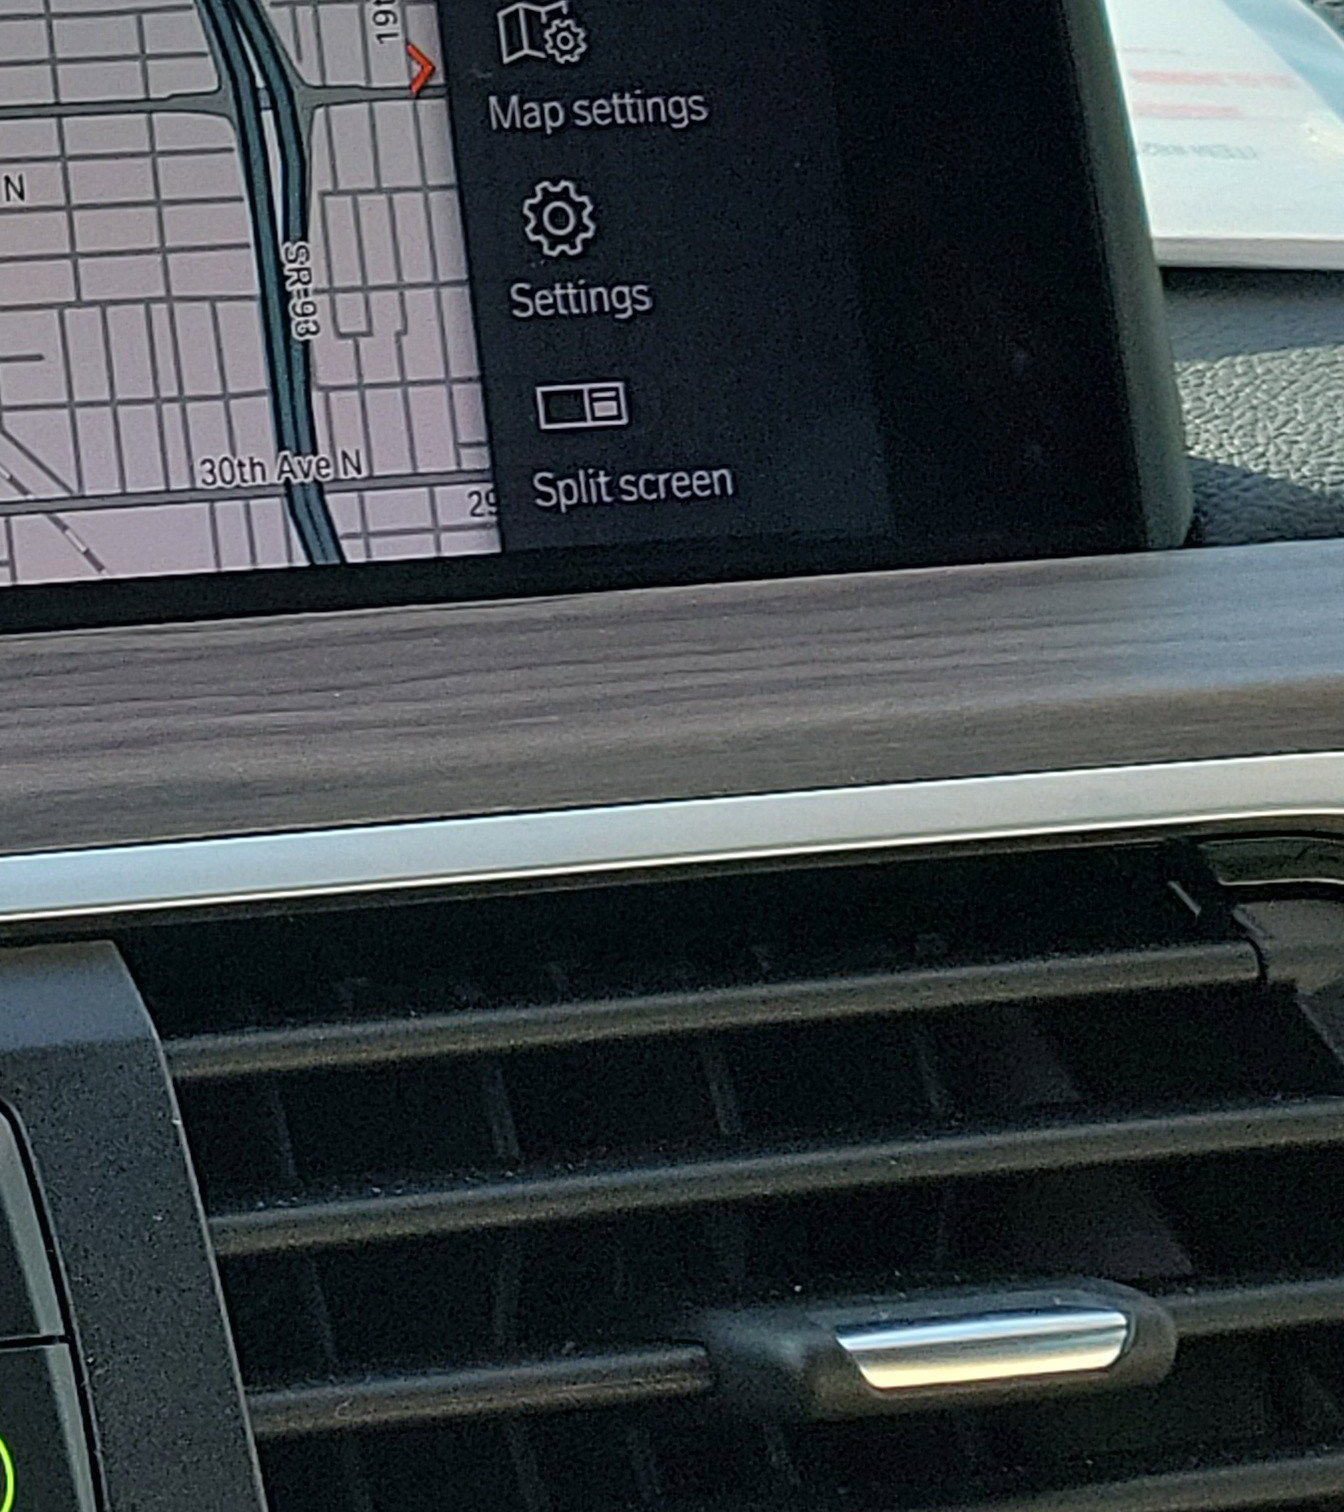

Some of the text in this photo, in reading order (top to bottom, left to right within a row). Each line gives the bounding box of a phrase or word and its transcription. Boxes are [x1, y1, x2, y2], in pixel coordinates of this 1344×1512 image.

[489, 91, 709, 133] Map settings
[4, 176, 25, 203] N
[511, 279, 653, 318] Settings
[199, 449, 362, 486] 30th Ave N
[533, 468, 733, 512] Split screen
